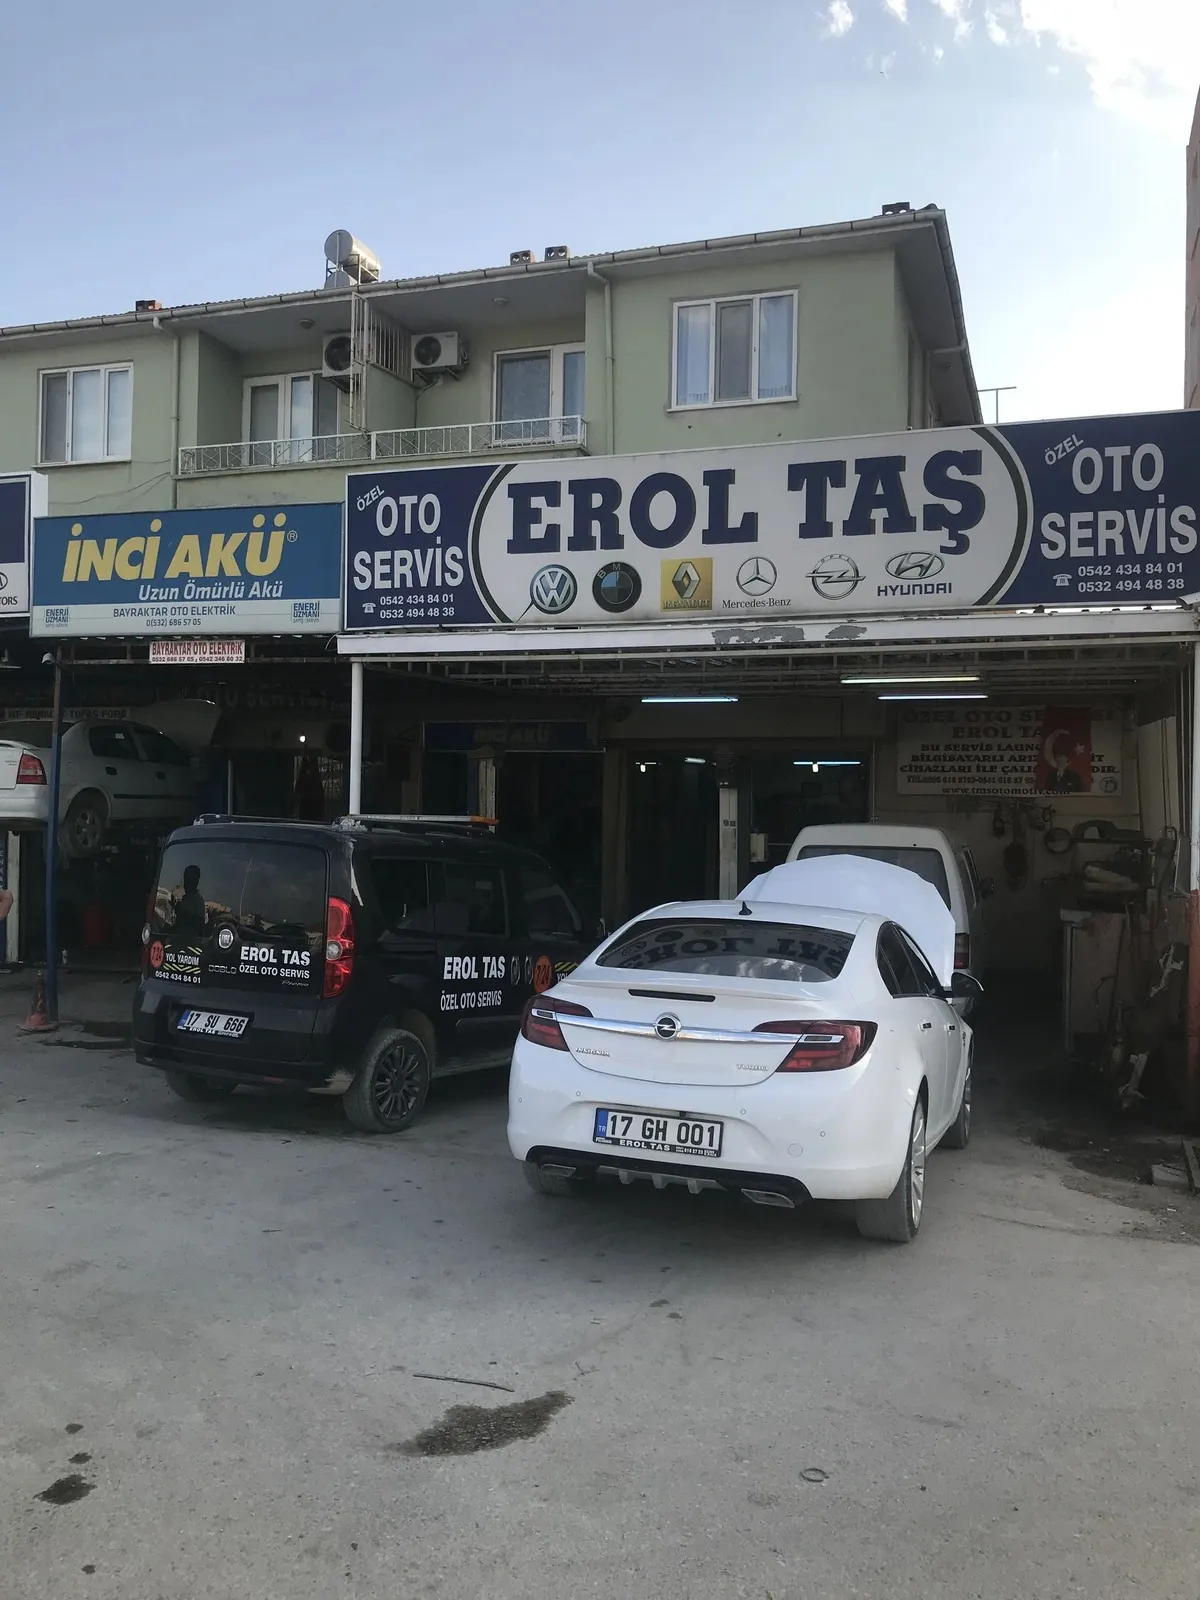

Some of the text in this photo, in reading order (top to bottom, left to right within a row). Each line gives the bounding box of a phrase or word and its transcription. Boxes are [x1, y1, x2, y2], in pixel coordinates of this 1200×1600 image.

[1044, 433, 1084, 465] ÖZEL
[1072, 443, 1164, 494] OTO
[357, 485, 385, 511] ÖZEL
[507, 450, 986, 555] EROL TAŞ
[376, 493, 441, 536] OTO
[1040, 494, 1198, 559] SERVİS
[62, 512, 286, 582] İNCİ AKÜ
[353, 536, 464, 590] SERVİS
[1078, 562, 1183, 576] 0542 434 84 01
[139, 580, 283, 600] Uzun Ömürlü Akü
[877, 582, 952, 596] HYUNDAI
[1078, 578, 1184, 593] 0532 494 48 38
[0, 596, 18, 606] ORS
[380, 593, 454, 606] 0542 434 84 01
[722, 598, 791, 609] Mercedes-Benz
[113, 604, 236, 618] BAYRAKTAR OTO ELEKTRİK
[380, 607, 455, 619] 0532 494 48 38
[146, 619, 168, 627] 0(532)
[183, 618, 191, 626] 57
[192, 618, 201, 626] 05
[152, 643, 192, 655] BAYRAKTAR
[193, 642, 207, 655] OTO
[953, 726, 1012, 739] EROL
[166, 953, 200, 966] YOL YARDIM
[240, 946, 278, 963] EROL
[208, 964, 237, 975] DOBLO
[239, 962, 259, 974] ÖZEL
[261, 966, 278, 976] OTO
[443, 956, 478, 980] EROL
[155, 970, 169, 979] 0542
[170, 973, 182, 981] 434
[440, 989, 458, 1011] ÖZEL
[460, 992, 476, 1008] OTO
[186, 1012, 245, 1032] 17 SU 666
[610, 1114, 715, 1147] 17 GH 001
[620, 1139, 648, 1149] EROL
